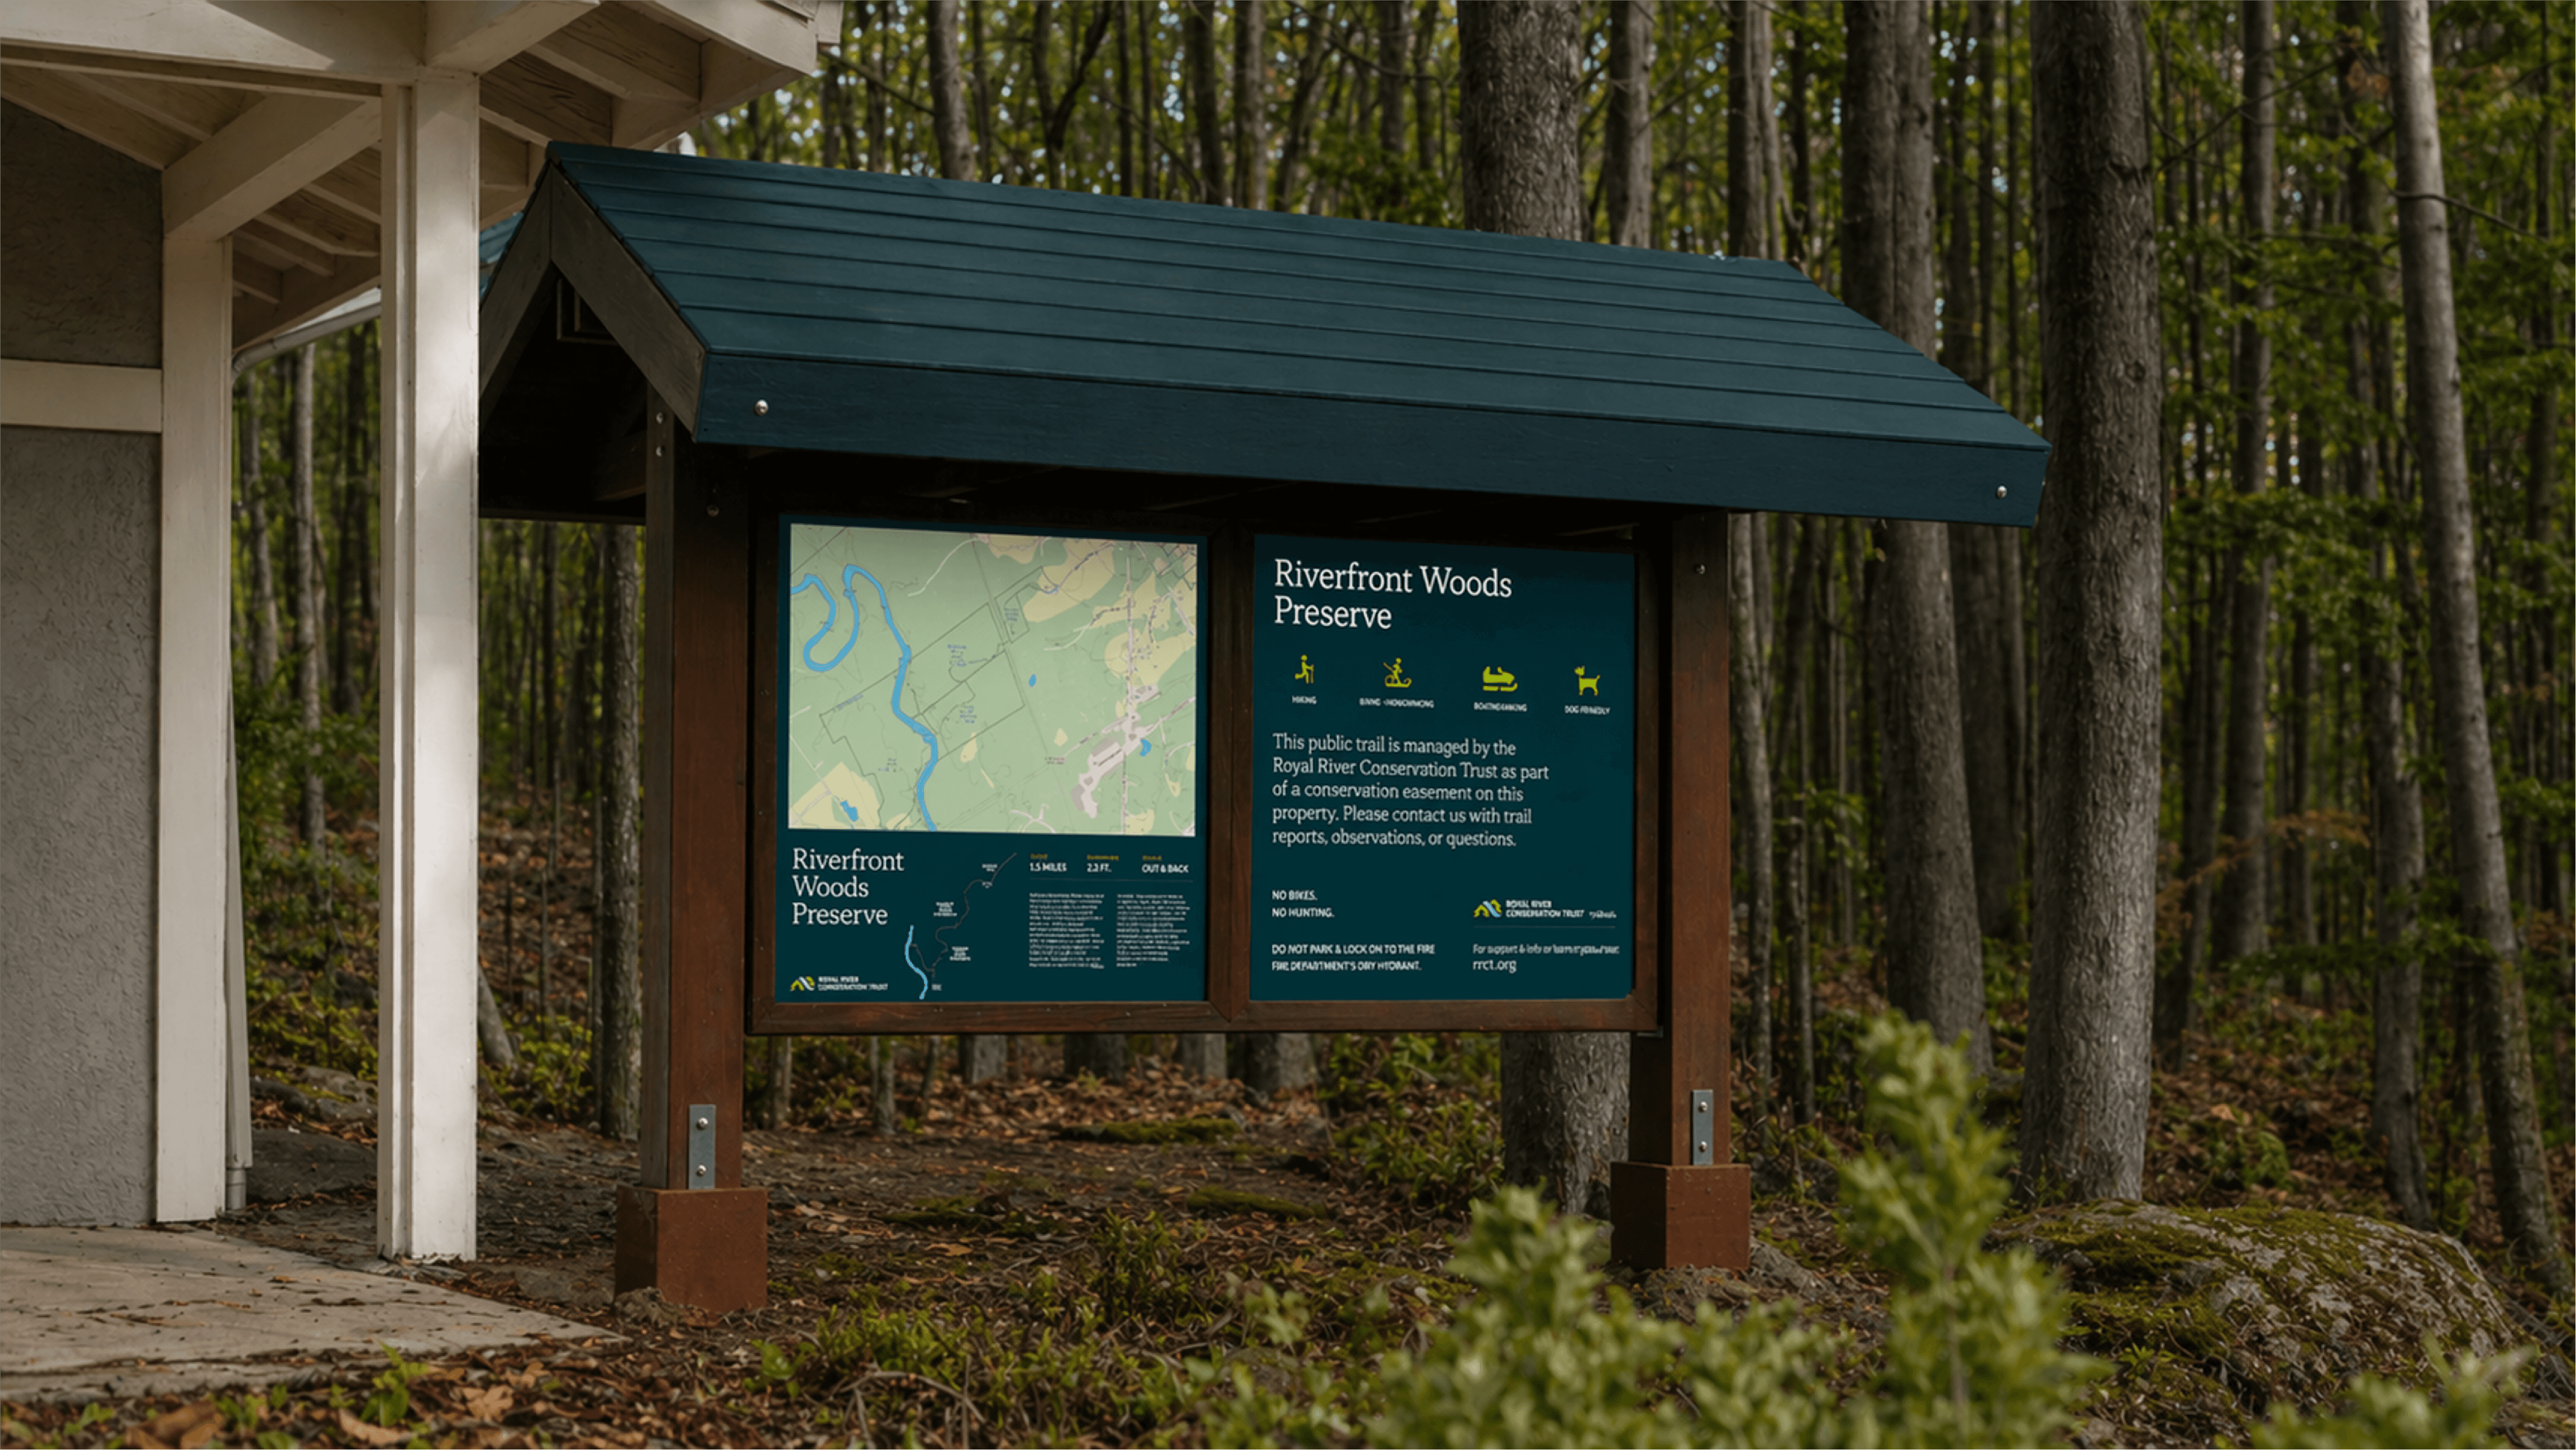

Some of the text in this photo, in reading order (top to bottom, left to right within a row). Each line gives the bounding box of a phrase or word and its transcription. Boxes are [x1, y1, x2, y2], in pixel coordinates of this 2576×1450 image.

[1276, 559, 1511, 597] Riverfront Woods
[1275, 596, 1391, 629] Preserve
[1273, 733, 1516, 758] This public trail is managed by the
[1274, 757, 1548, 783] Royal River Conservation Trust as part
[1272, 780, 1523, 801] of a conservation easement on this
[1273, 805, 1531, 824] property. Please contact us with trail
[1273, 828, 1516, 849] reports, observations, or questions.
[793, 848, 904, 871] Riverfront
[1168, 865, 1188, 873] BACK
[793, 875, 869, 897] Woods
[1272, 890, 1286, 900] NO
[793, 903, 888, 925] Preserve
[1272, 907, 1335, 917] NO HUNTING.
[1272, 944, 1286, 954] DO
[1288, 944, 1308, 954] NOT
[1369, 944, 1382, 954] ON
[1385, 944, 1397, 954] TO
